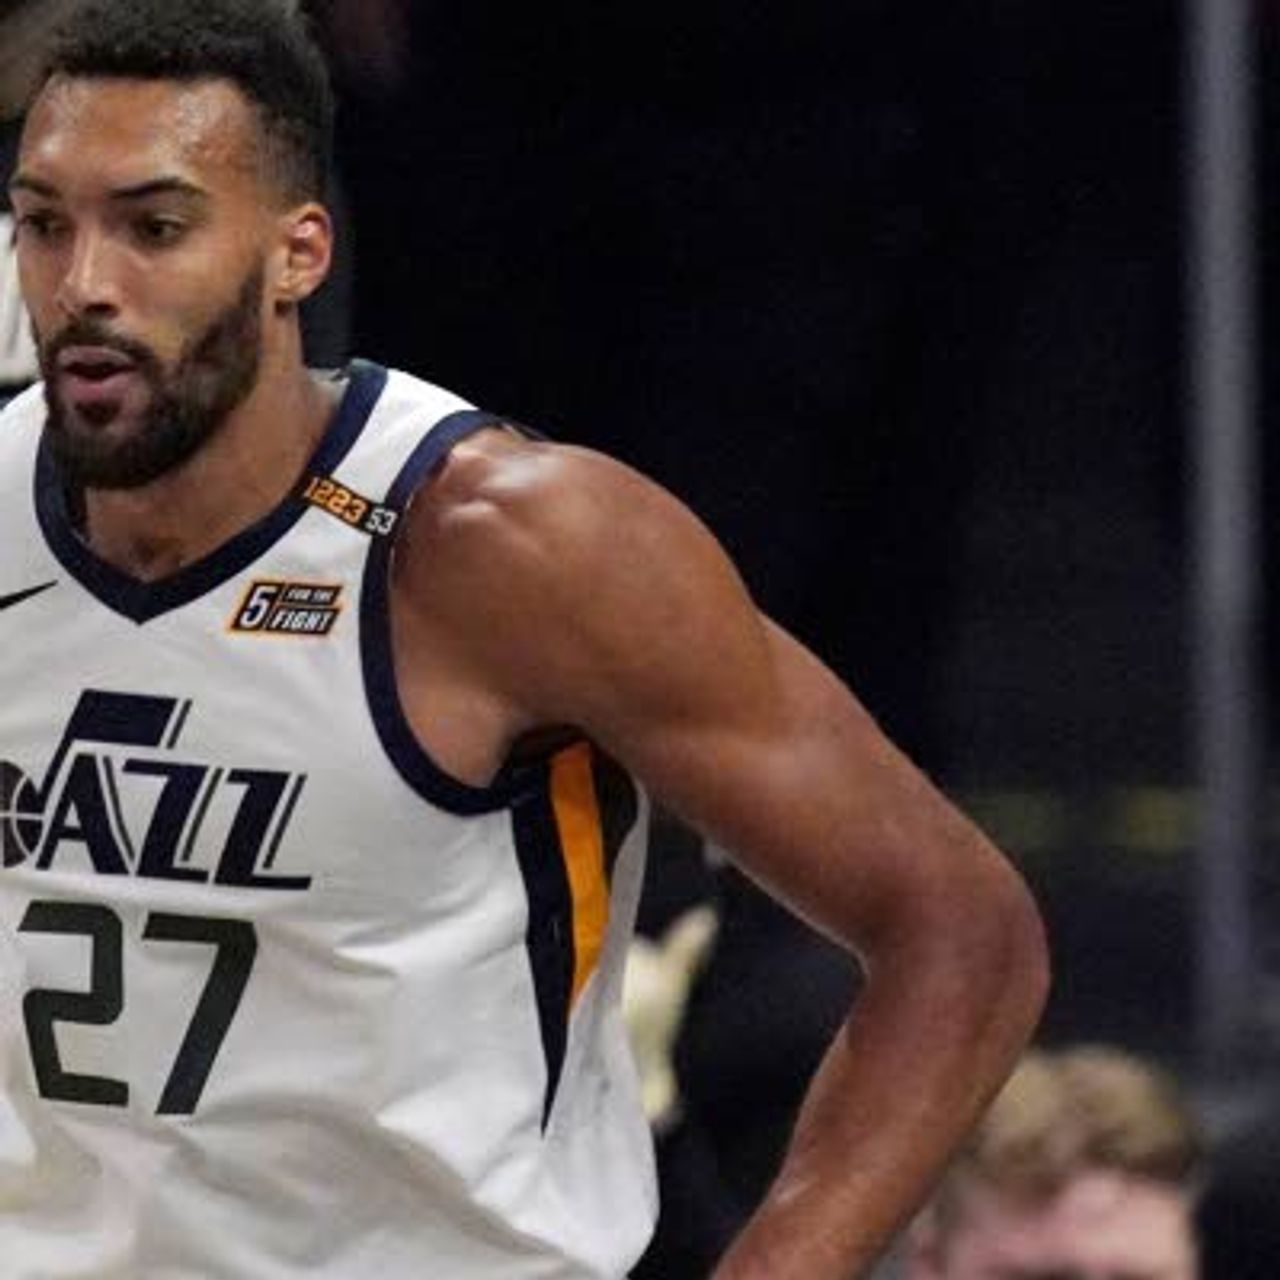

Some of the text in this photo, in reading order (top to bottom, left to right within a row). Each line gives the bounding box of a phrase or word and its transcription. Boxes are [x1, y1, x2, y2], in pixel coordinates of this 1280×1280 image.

[366, 508, 398, 536] 53
[239, 585, 279, 629] 5
[271, 609, 334, 632] FIGHT
[17, 899, 258, 1116] 27
